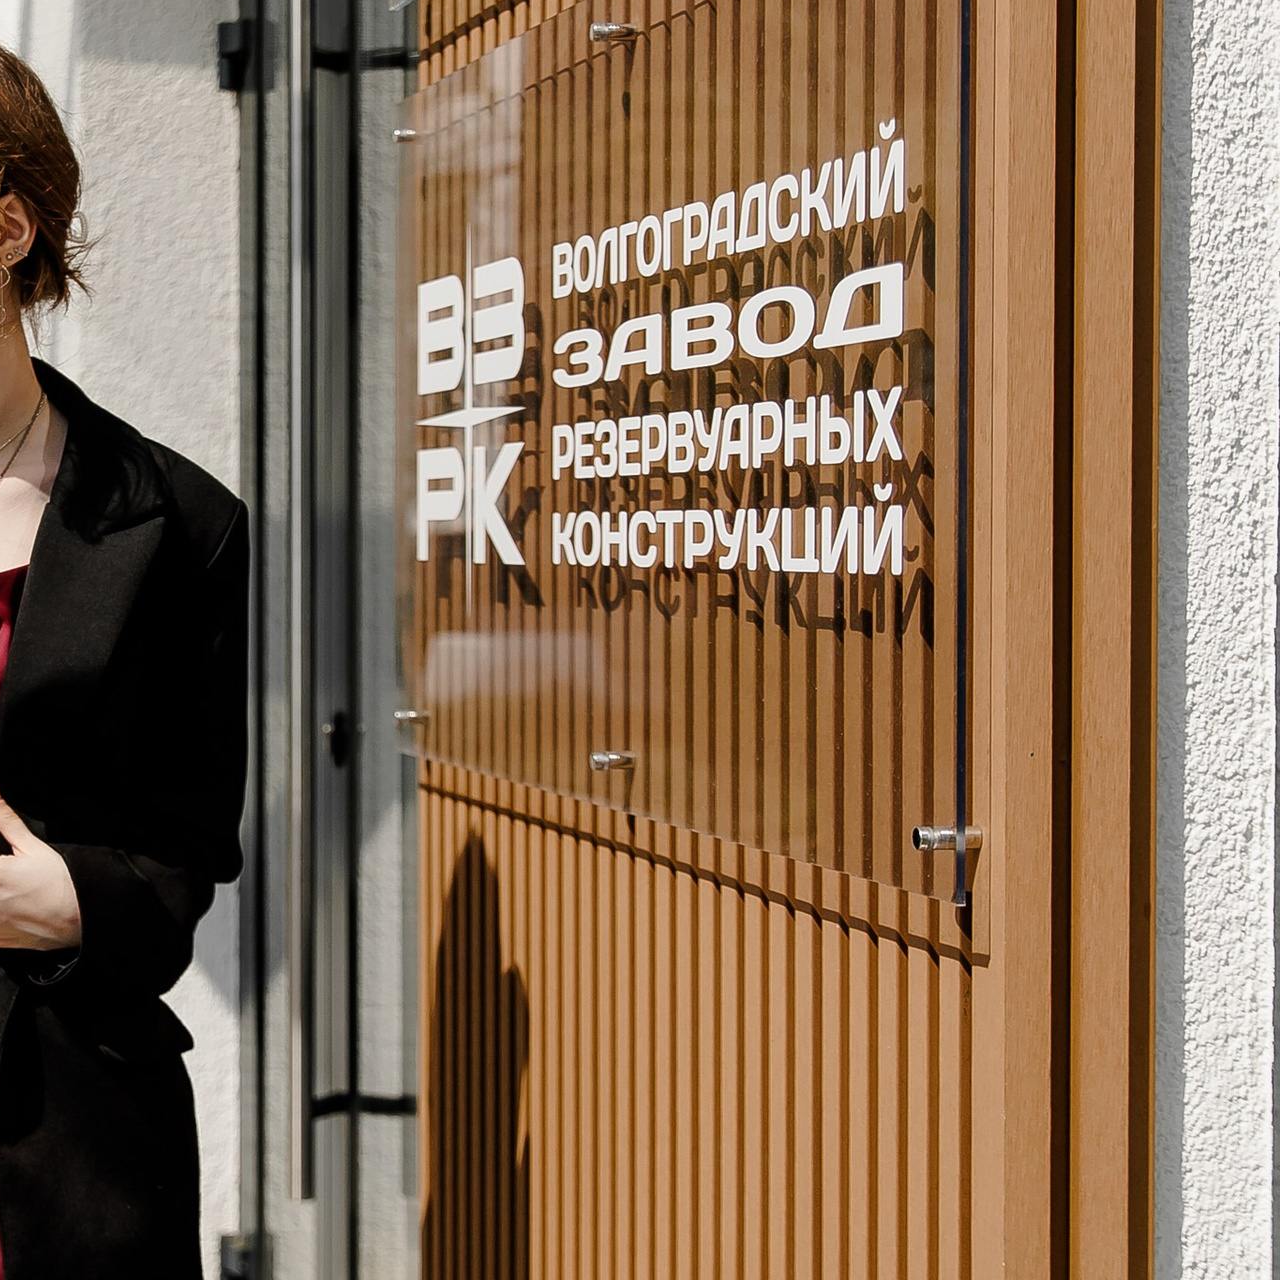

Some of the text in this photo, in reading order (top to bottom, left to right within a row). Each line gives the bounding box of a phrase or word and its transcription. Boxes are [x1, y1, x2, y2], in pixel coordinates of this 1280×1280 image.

[552, 117, 904, 300] ВОЛГОГРАДСКИЙ
[551, 262, 904, 389] ЗАВОД
[552, 386, 903, 481] РЕЗЕРВУАРНЫХ
[416, 441, 526, 566] РК
[552, 483, 903, 576] КОНСТРУКЦИЙ
